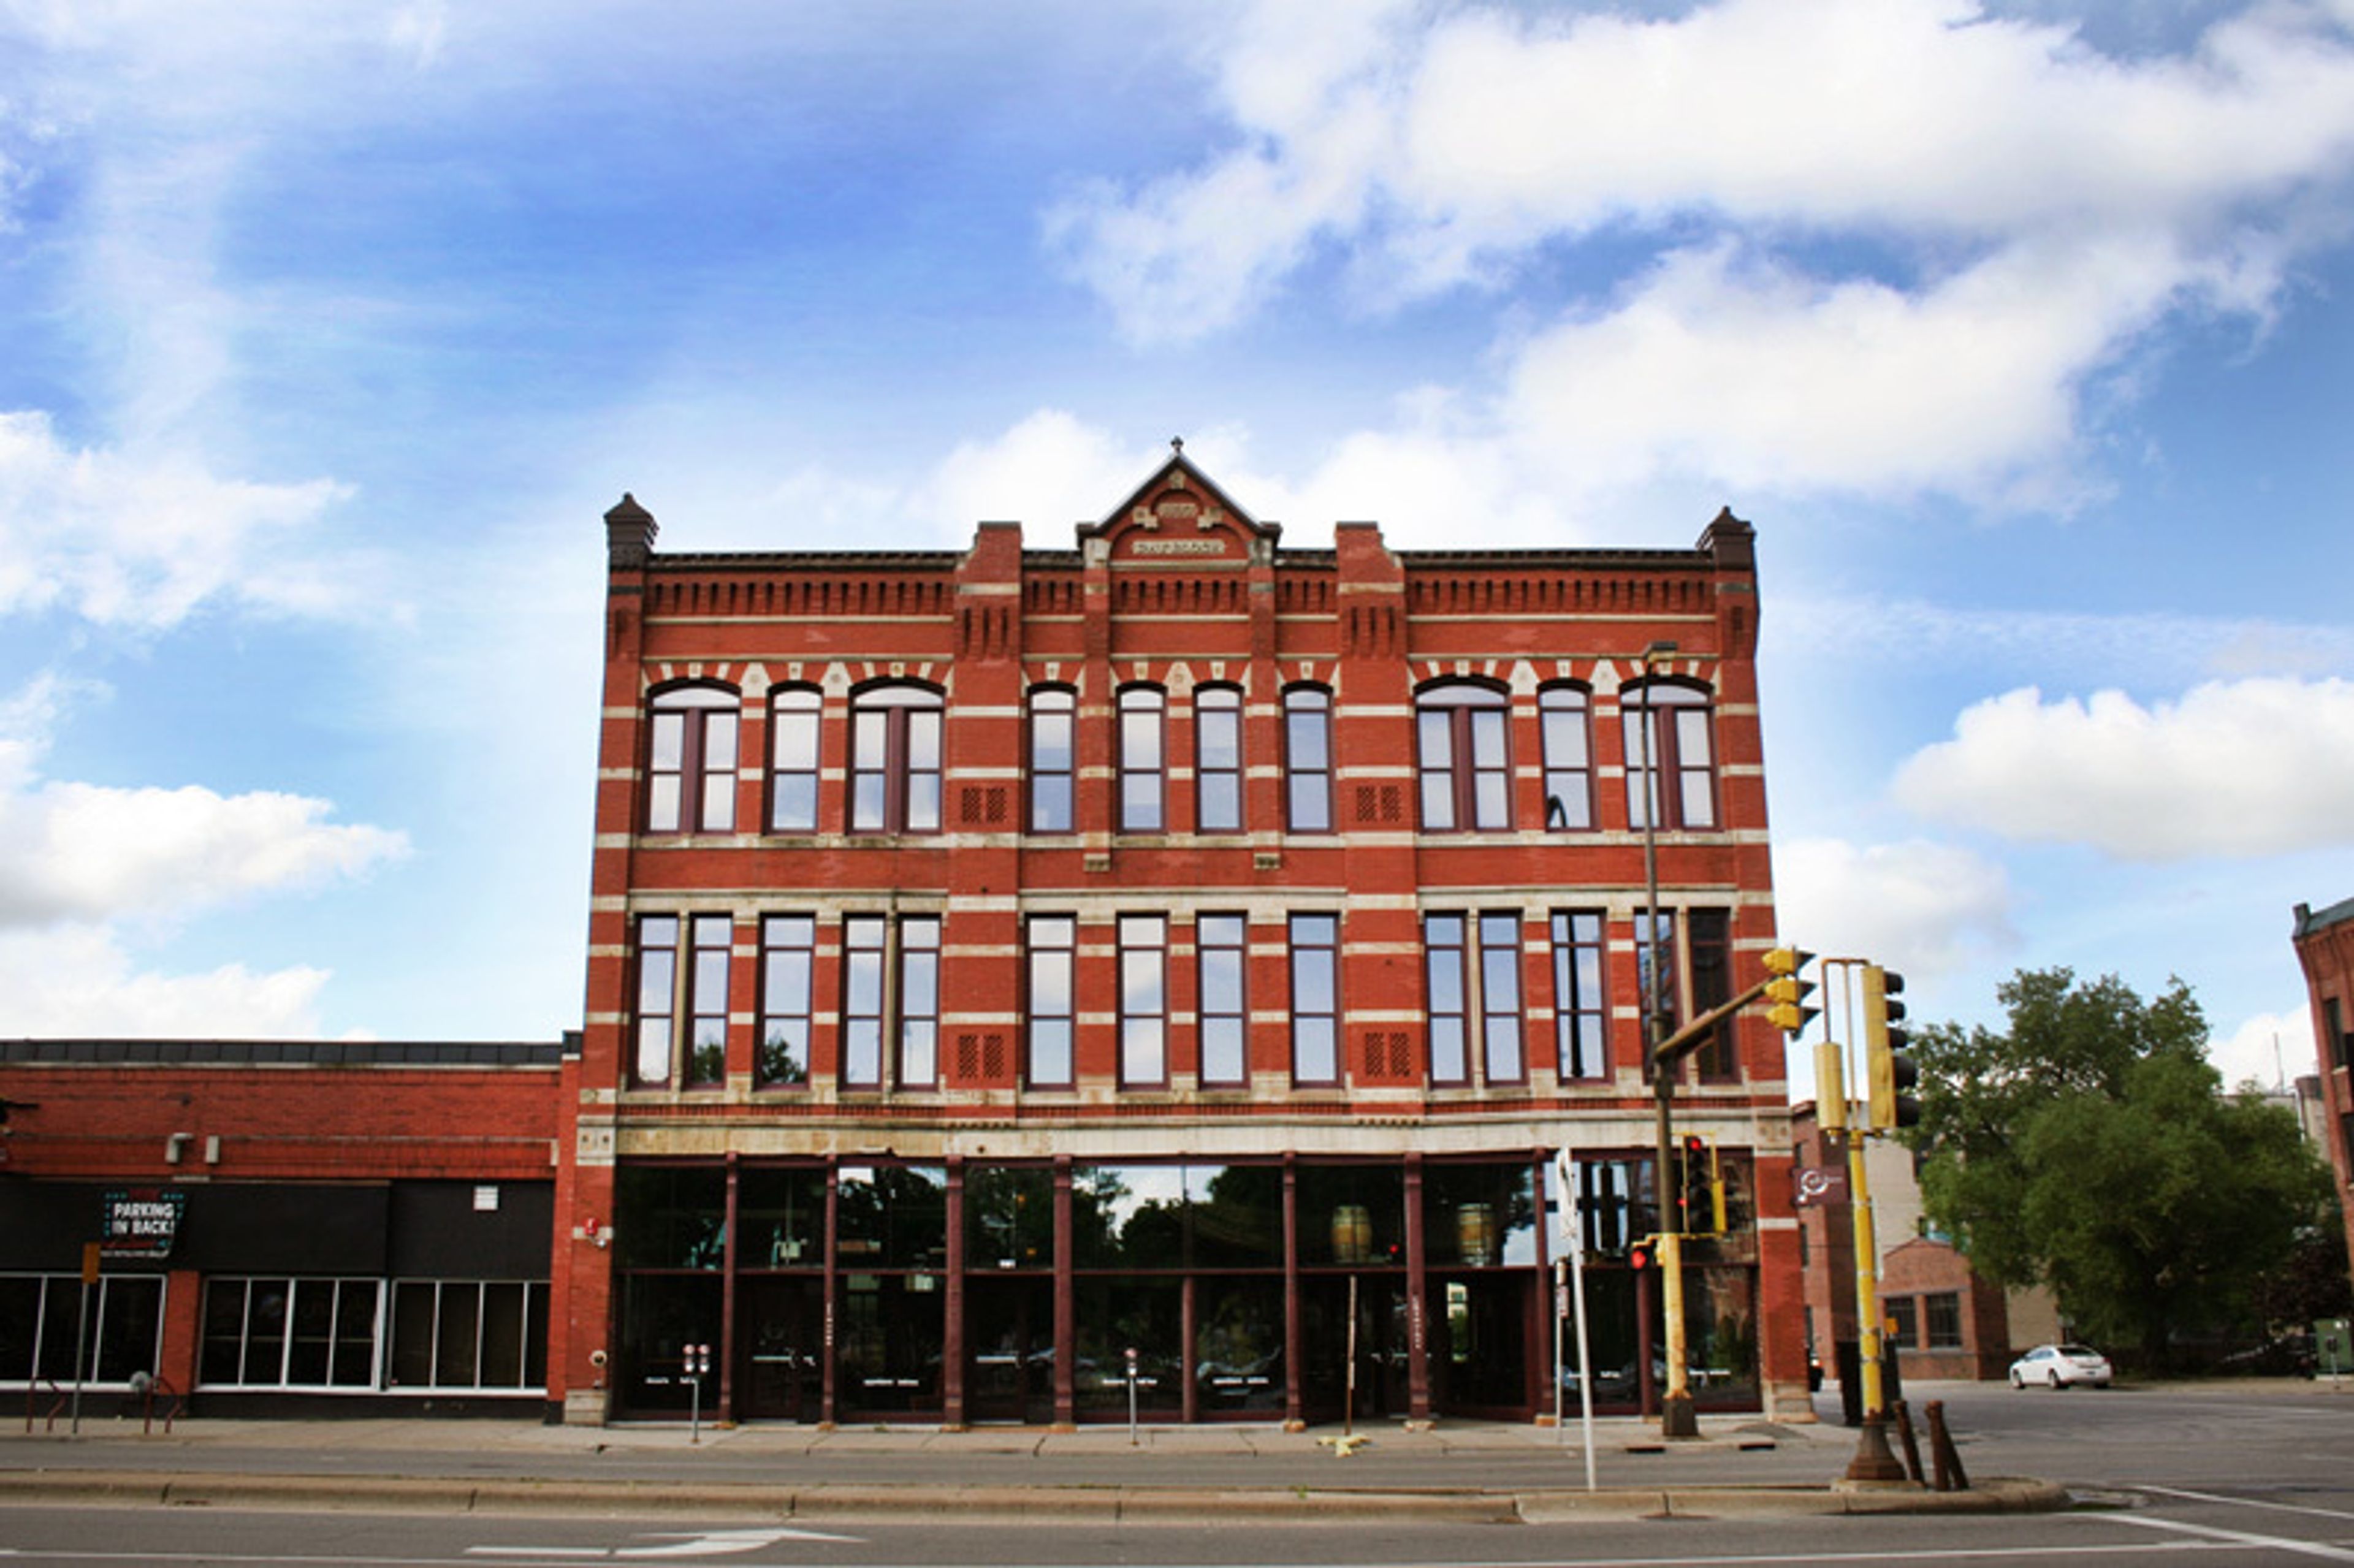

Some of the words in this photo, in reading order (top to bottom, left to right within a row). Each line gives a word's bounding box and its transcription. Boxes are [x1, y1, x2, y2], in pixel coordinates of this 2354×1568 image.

[113, 1203, 175, 1218] PARKING
[112, 1220, 129, 1235] IN
[132, 1220, 175, 1235] BACK!
